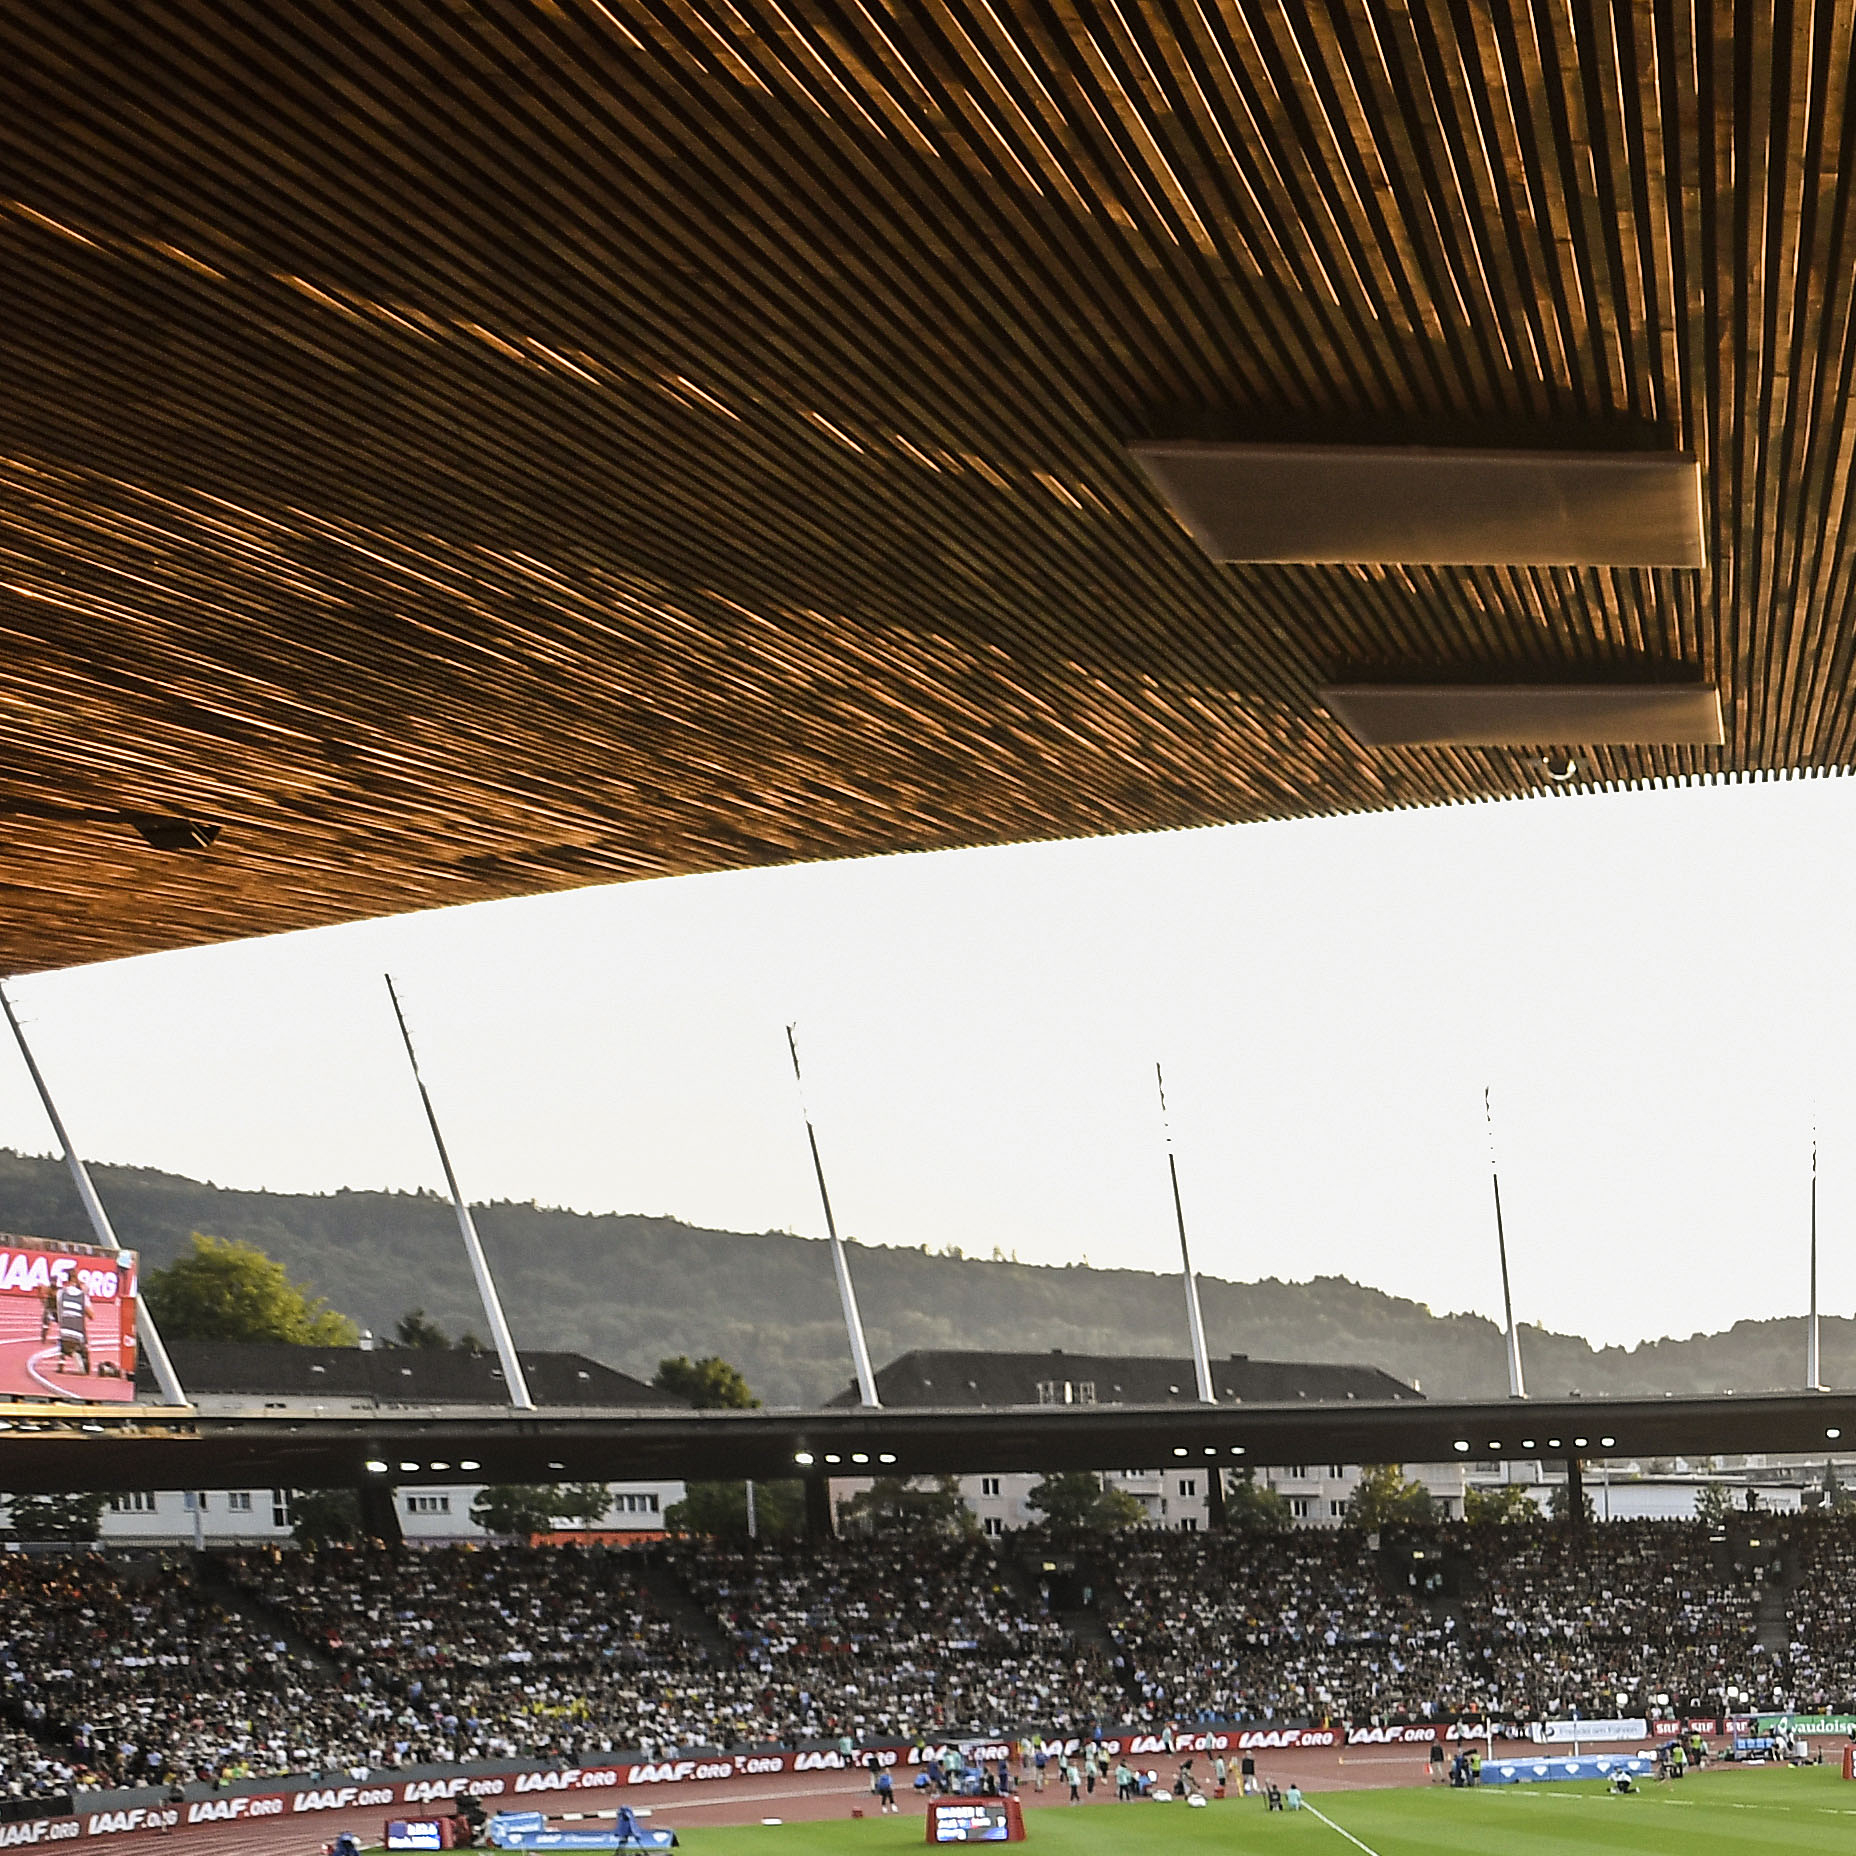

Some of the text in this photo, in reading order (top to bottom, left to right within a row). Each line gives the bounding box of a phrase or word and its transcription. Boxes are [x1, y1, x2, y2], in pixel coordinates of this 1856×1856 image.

[1238, 1729, 1333, 1750] IAAF.ORG
[514, 1768, 618, 1793] IAAF.ORG
[628, 1760, 732, 1785] IAAF.ORG
[188, 1798, 284, 1824] IAAF.ORG
[293, 1786, 394, 1813] IAAF.ORG
